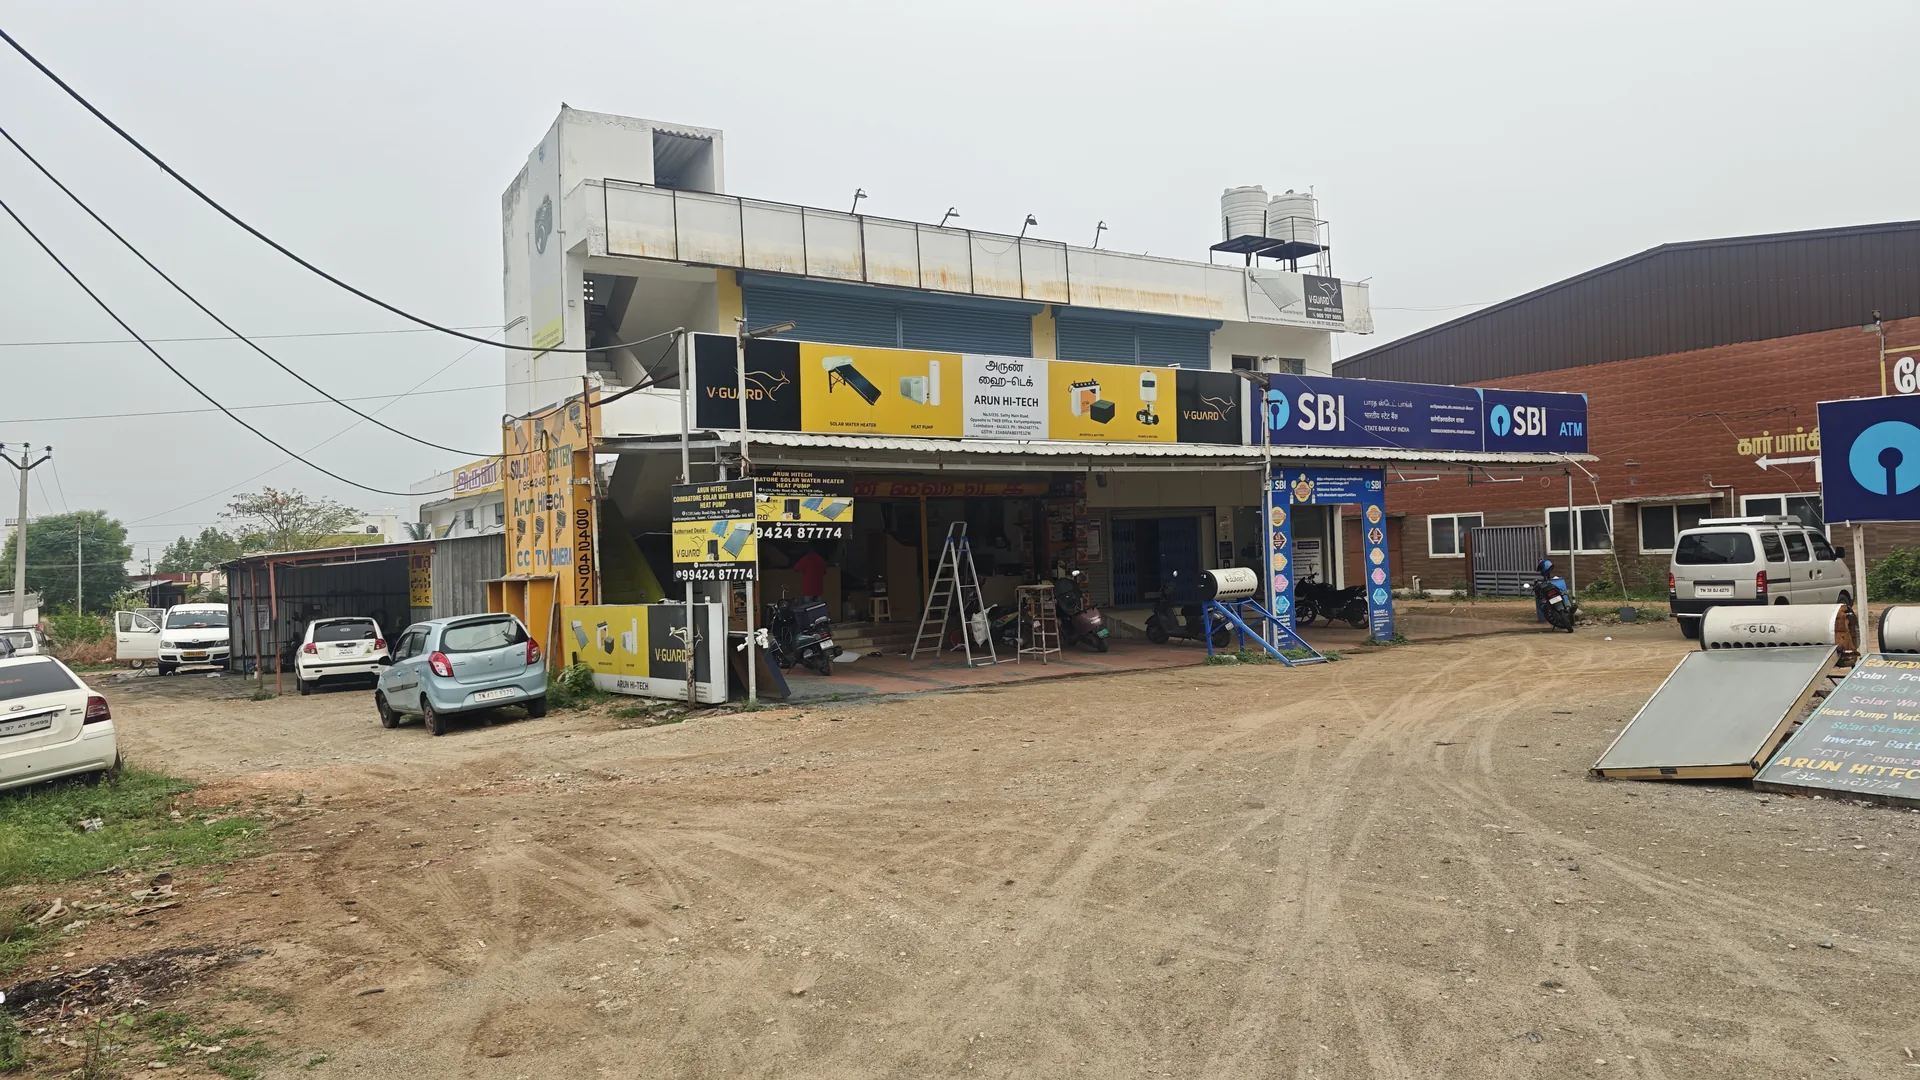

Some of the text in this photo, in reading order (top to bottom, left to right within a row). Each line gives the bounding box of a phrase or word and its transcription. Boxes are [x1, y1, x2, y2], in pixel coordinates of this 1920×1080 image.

[1308, 294, 1330, 306] V-GUARD
[985, 360, 1024, 375] அருண்
[978, 375, 1034, 388] ஹை-டெக்
[706, 386, 763, 401] V-GURD
[974, 394, 1039, 408] ARUN HI-TECH
[1183, 410, 1220, 422] V-GUARD
[1297, 392, 1345, 432] SBI
[1513, 406, 1582, 436] SBI ATM
[1737, 430, 1774, 456] கார்
[533, 452, 546, 474] UPS
[548, 443, 574, 471] BATTERY
[1274, 480, 1287, 490] SBI
[1370, 480, 1381, 490] SBI
[673, 495, 702, 503] COIMBATORE
[735, 491, 753, 499] HEATER
[514, 497, 535, 518] Arun
[757, 527, 842, 539] 9424 87774
[517, 548, 572, 567] CC TV CAMERA
[682, 568, 753, 580] 99424 87774
[655, 648, 687, 662] V-GUARD
[617, 680, 649, 691] ARUN HI-TECH
[1845, 683, 1910, 694] On Grid
[1850, 696, 1920, 707] Solar Wa
[1818, 707, 1851, 716] Heat
[1852, 709, 1888, 720] Pump
[1831, 721, 1916, 736] Solar Street
[1774, 756, 1844, 772] ARUN
